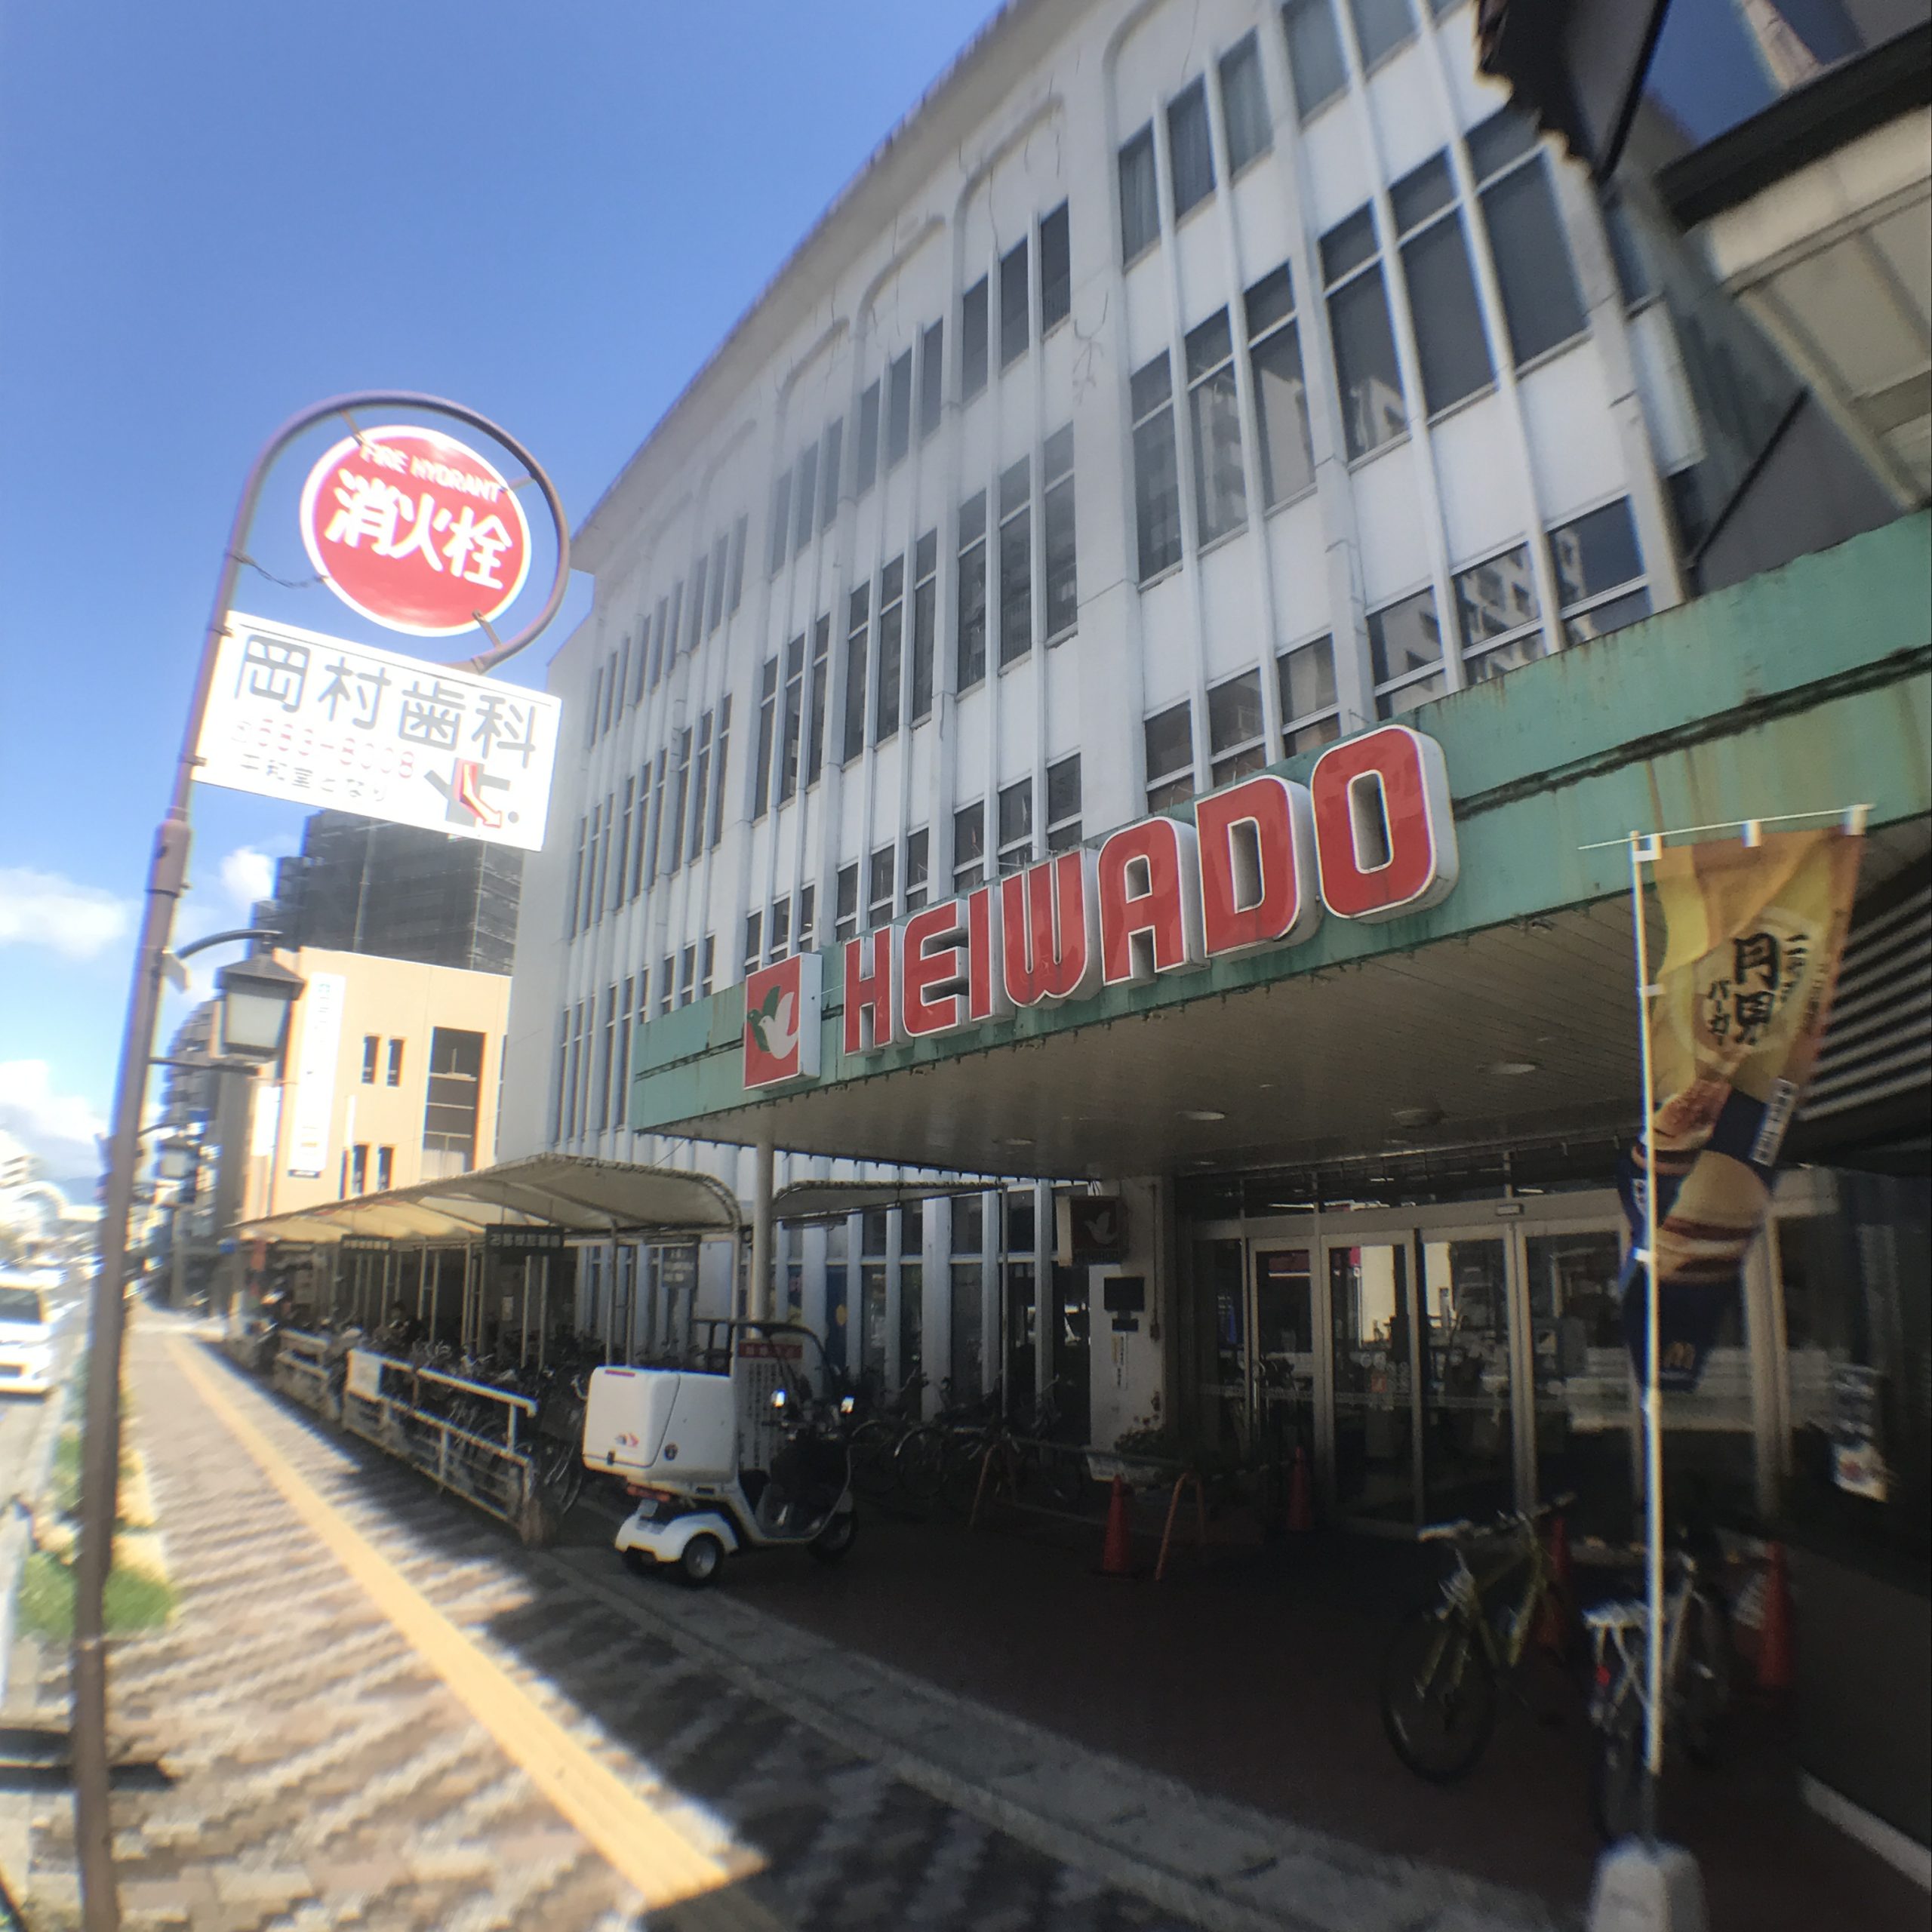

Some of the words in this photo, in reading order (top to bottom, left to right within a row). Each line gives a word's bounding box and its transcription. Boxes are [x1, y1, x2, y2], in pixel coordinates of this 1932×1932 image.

[325, 468, 514, 590] 消火栓
[410, 457, 503, 504] HYDRANT
[235, 635, 537, 769] 岡村歯科
[844, 724, 1457, 1057] HEIWADO
